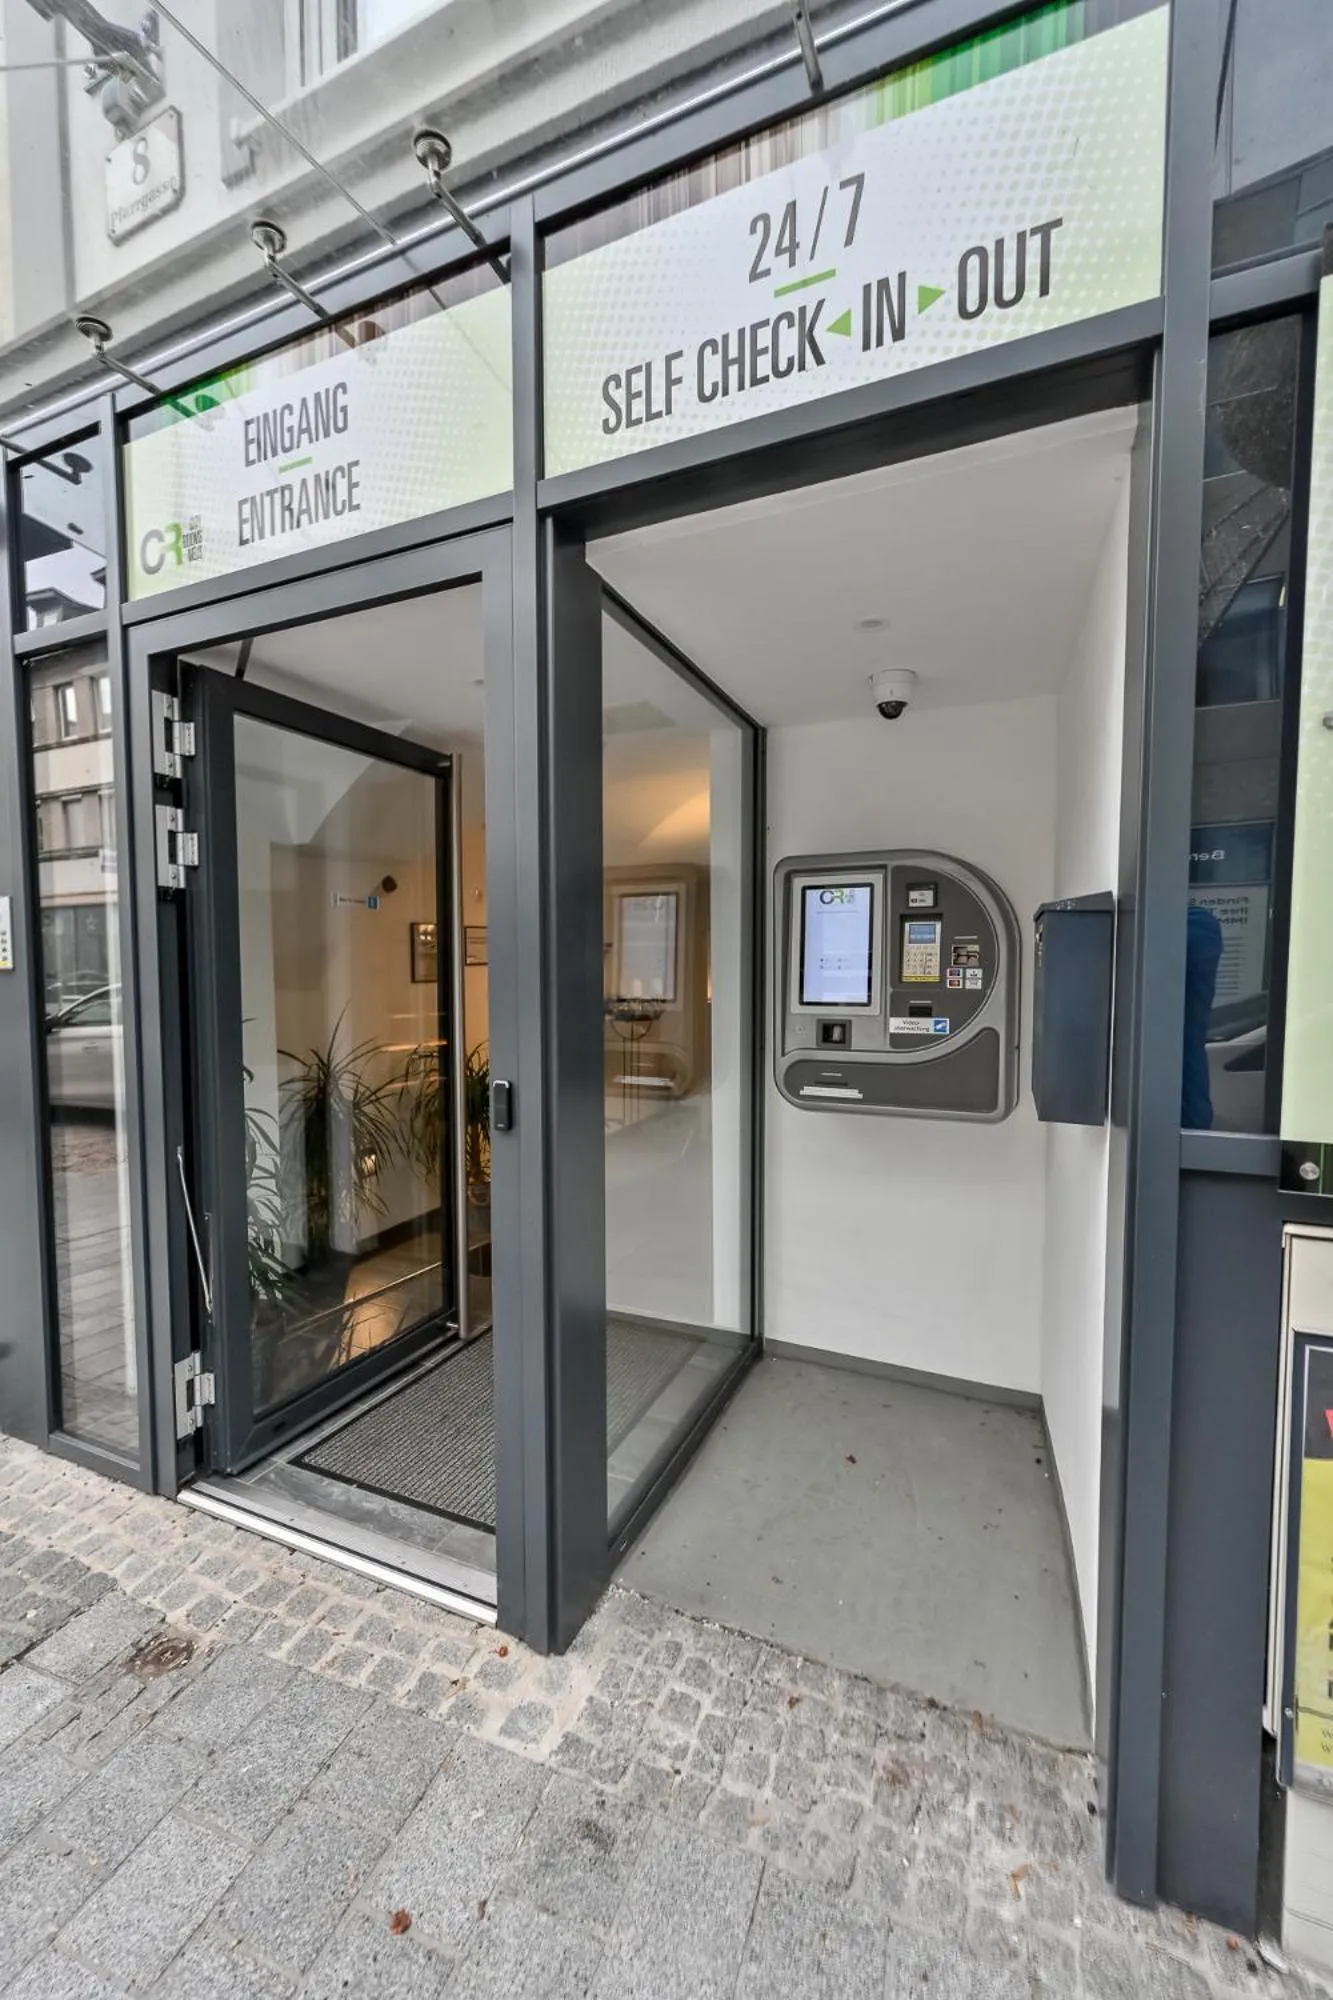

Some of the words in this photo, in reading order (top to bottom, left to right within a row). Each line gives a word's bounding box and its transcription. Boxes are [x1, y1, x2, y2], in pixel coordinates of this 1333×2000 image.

[132, 136, 150, 185] 8
[748, 171, 866, 284] 24/7
[602, 349, 684, 435] SELF
[696, 297, 827, 404] CHECK
[861, 270, 906, 353] IN
[957, 216, 1064, 321] OUT
[243, 381, 349, 468] EINGANG
[237, 459, 361, 547] ENTRANCE
